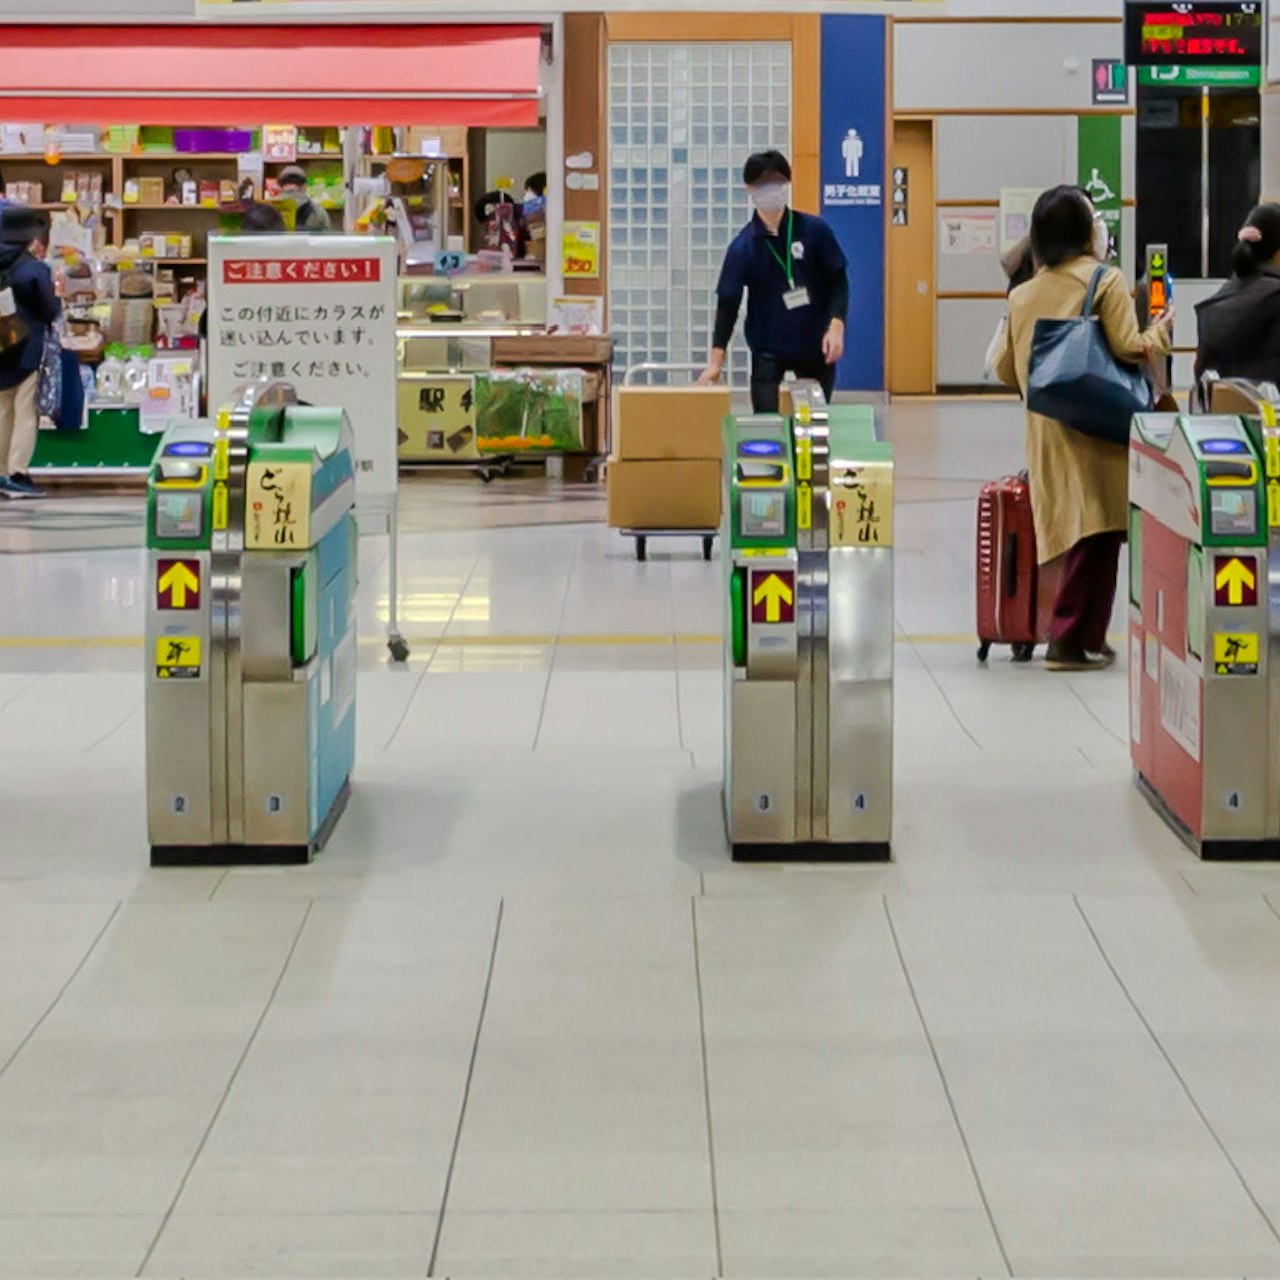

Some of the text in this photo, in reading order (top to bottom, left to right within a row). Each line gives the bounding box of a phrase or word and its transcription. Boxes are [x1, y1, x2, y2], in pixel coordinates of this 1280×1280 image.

[221, 303, 385, 323] この付近にカラスが
[220, 325, 374, 347] 迷い込んでいます。
[233, 360, 370, 378] ご注意ください。
